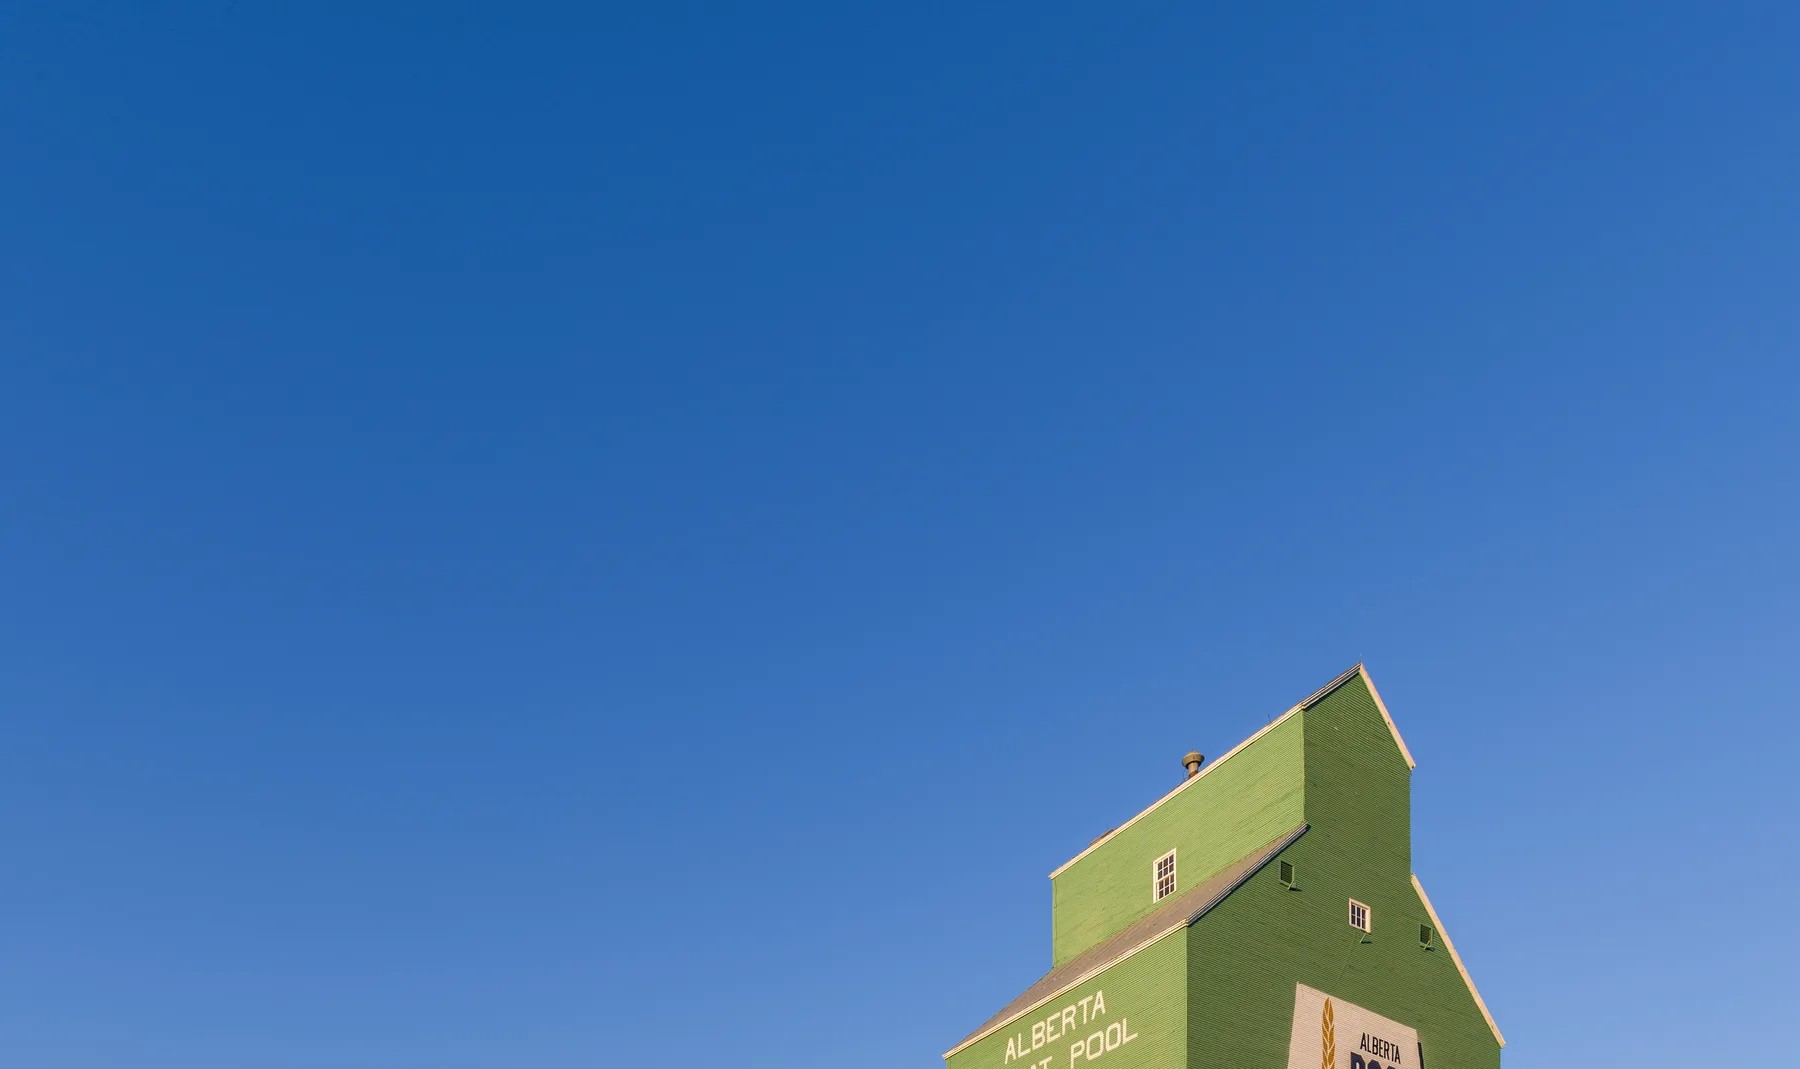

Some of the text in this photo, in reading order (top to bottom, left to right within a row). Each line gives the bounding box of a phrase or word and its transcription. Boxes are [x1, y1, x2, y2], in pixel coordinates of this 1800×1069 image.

[1004, 990, 1106, 1065] ALBERTA
[1070, 1018, 1139, 1069] POOL
[1360, 1032, 1401, 1065] ALBERTA
